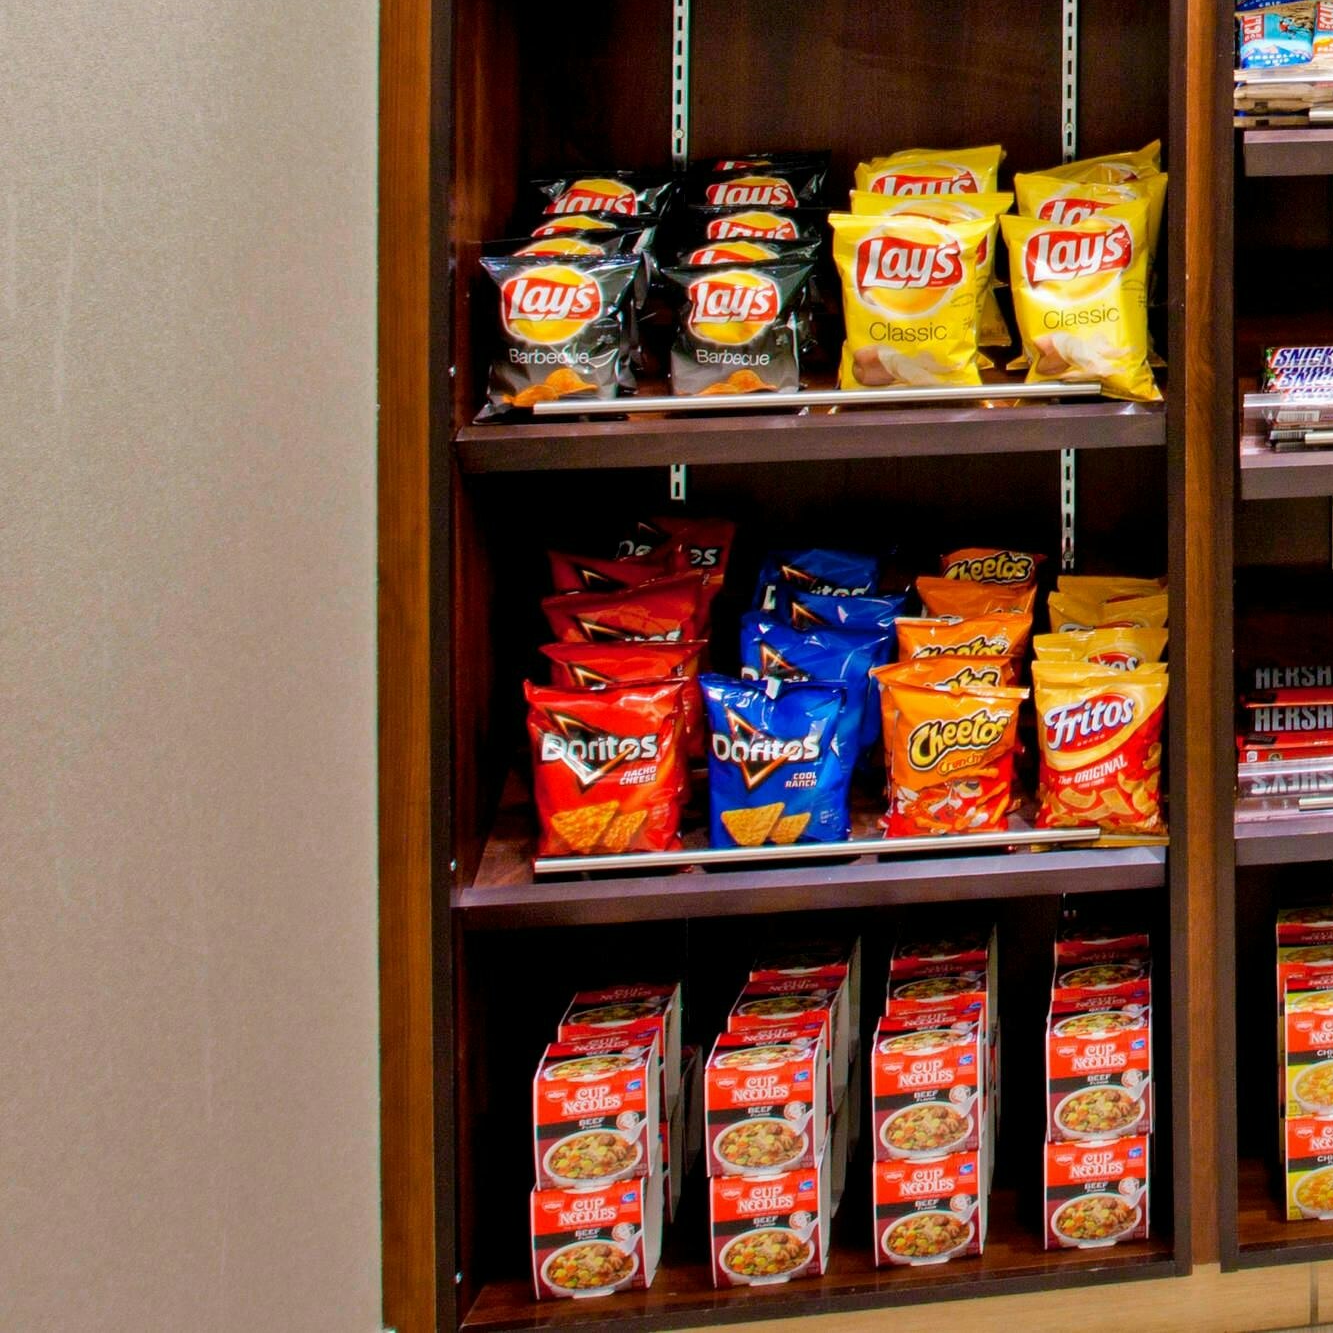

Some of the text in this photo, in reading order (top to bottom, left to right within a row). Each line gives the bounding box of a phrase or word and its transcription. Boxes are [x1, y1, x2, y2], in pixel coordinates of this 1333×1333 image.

[1033, 225, 1128, 282] Lay's
[862, 240, 958, 289] Lay's
[509, 278, 598, 321] Lay's
[697, 282, 774, 324] Lay's
[1044, 306, 1120, 330] Classic
[869, 321, 947, 342] Classic
[509, 348, 589, 365] Barbecue
[696, 350, 769, 366] Barbecue
[1045, 697, 1135, 749] Fritos
[541, 733, 658, 761] Doritos
[712, 734, 820, 761] Doritos
[908, 710, 1010, 771] Cheetos
[624, 766, 656, 776] NACHO
[792, 771, 816, 780] COOL
[1074, 755, 1127, 783] ORIGINAL
[619, 774, 657, 785] CHEESE
[785, 779, 817, 788] RANCH
[911, 1059, 942, 1073] CUP
[899, 1070, 954, 1088] NOODLES
[575, 1086, 610, 1102] CUP
[914, 1090, 938, 1099] BEEF
[563, 1096, 621, 1113] NOODLES
[579, 1117, 604, 1128] BEEF
